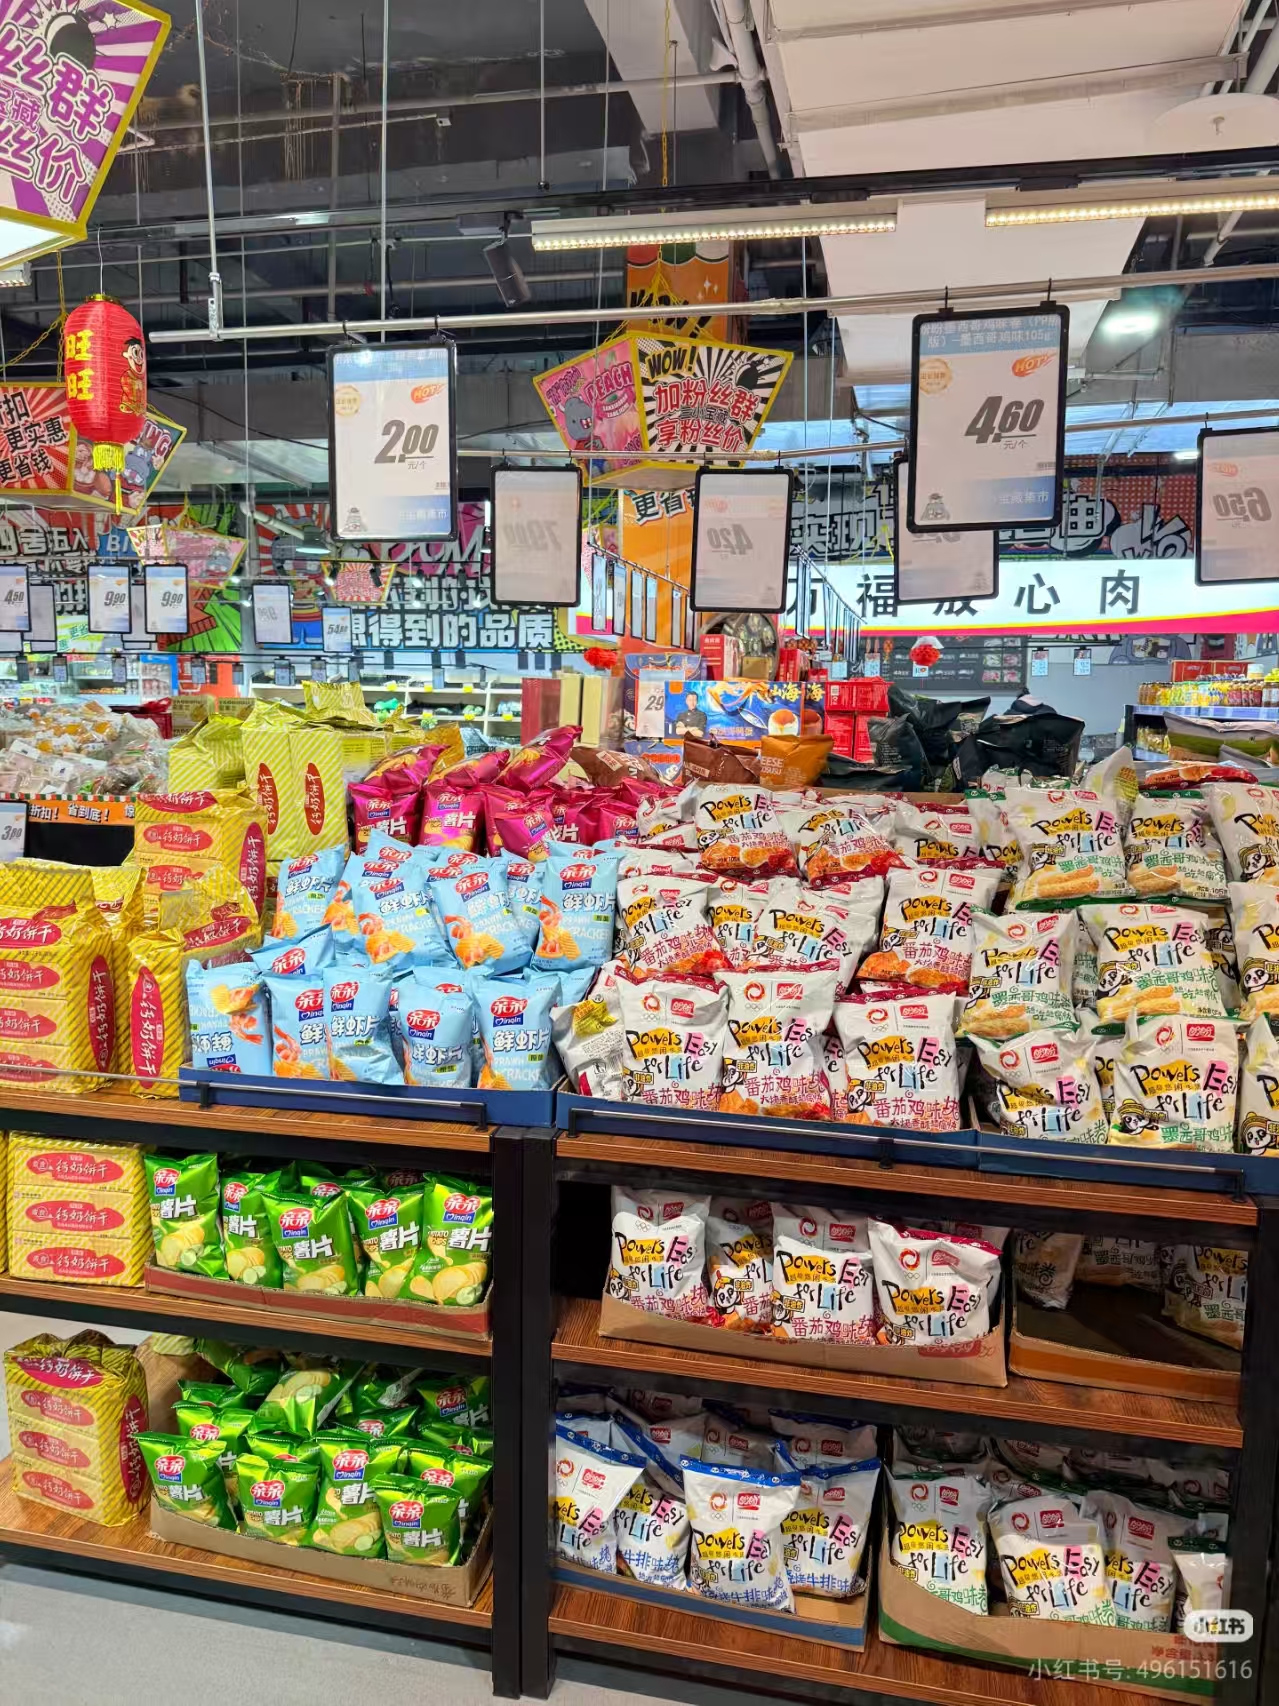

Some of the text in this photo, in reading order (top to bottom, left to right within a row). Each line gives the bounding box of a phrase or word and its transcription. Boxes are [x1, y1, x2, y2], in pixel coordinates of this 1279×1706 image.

[66, 331, 95, 401] 旺旺
[646, 345, 698, 379] WOW!
[585, 361, 633, 403] PEACH
[654, 377, 760, 421] 加粉丝群
[964, 395, 1046, 444] 4.60
[4, 415, 68, 453] 更实惠
[374, 419, 440, 464] 2.00
[656, 417, 745, 453] 享粉丝价
[68, 802, 111, 822] 省到底！
[444, 811, 476, 829] 薯片
[699, 795, 753, 822] Powers
[741, 810, 773, 830] Life
[163, 831, 201, 846] 钙奶饼干
[456, 874, 489, 893] 亲亲
[561, 865, 596, 880] 亲亲
[562, 893, 615, 913] 鲜虾片
[899, 897, 952, 922] Powers
[648, 907, 684, 934] Life
[769, 908, 826, 935] Powers
[930, 916, 968, 940] Life
[797, 935, 834, 961] Life
[1103, 925, 1169, 951] Powers
[272, 951, 305, 973] 亲亲
[1128, 942, 1196, 967] for Life
[331, 983, 358, 1001] 亲亲
[491, 997, 527, 1015] 亲亲
[407, 1011, 440, 1028] 亲亲
[728, 1017, 783, 1048] Powers
[138, 1000, 158, 1076] 钙奶饼干
[493, 1030, 551, 1053] 鲜虾片
[625, 1029, 683, 1060] Powers
[684, 1032, 719, 1056] Easy
[747, 1043, 805, 1068] for Life
[856, 1037, 953, 1069] Powers Easy
[642, 1054, 704, 1080] for Life
[874, 1063, 938, 1090] for Life
[1129, 1062, 1238, 1097] Powers Easy
[744, 1072, 825, 1098] 番茄鸡味块
[873, 1095, 960, 1121] 番茄鸡味块
[1041, 1106, 1083, 1133] Life
[1155, 1092, 1227, 1121] for Life
[56, 1159, 108, 1179] 钙奶饼干
[155, 1169, 179, 1186] 亲亲
[225, 1184, 245, 1201] 亲亲
[444, 1195, 480, 1213] 亲亲
[55, 1206, 108, 1226] 钙奶饼干
[160, 1194, 197, 1219] 薯片
[280, 1209, 311, 1227] 亲亲
[366, 1199, 400, 1218] 亲亲
[228, 1214, 257, 1238] 薯片
[379, 1221, 420, 1251] 薯片
[448, 1226, 492, 1252] 薯片
[293, 1233, 333, 1259] 薯片
[614, 1231, 666, 1263] Powers
[57, 1254, 110, 1273] 钙奶饼干
[629, 1263, 684, 1290] for Life
[776, 1250, 837, 1283] Powers
[794, 1282, 857, 1311] for Life
[881, 1279, 945, 1313] Powers
[791, 1315, 875, 1338] 番茄鸡味块
[926, 1313, 968, 1337] Life
[155, 1457, 185, 1473] 亲亲
[334, 1452, 369, 1470] 亲亲
[169, 1484, 204, 1501] 薯片
[251, 1482, 285, 1500] 亲亲
[264, 1505, 303, 1526] 薯片
[389, 1503, 424, 1521] 亲亲
[651, 1494, 685, 1526] Easy
[403, 1528, 443, 1548] 薯片
[628, 1511, 664, 1542] Life
[898, 1521, 985, 1558] Powers Easy
[693, 1528, 746, 1559] Powers
[808, 1535, 846, 1566] Life
[728, 1558, 766, 1582] Life
[931, 1551, 970, 1581] Life
[1001, 1547, 1101, 1587] Powers Easy
[1047, 1579, 1090, 1609] Life
[1112, 1579, 1151, 1612] Life
